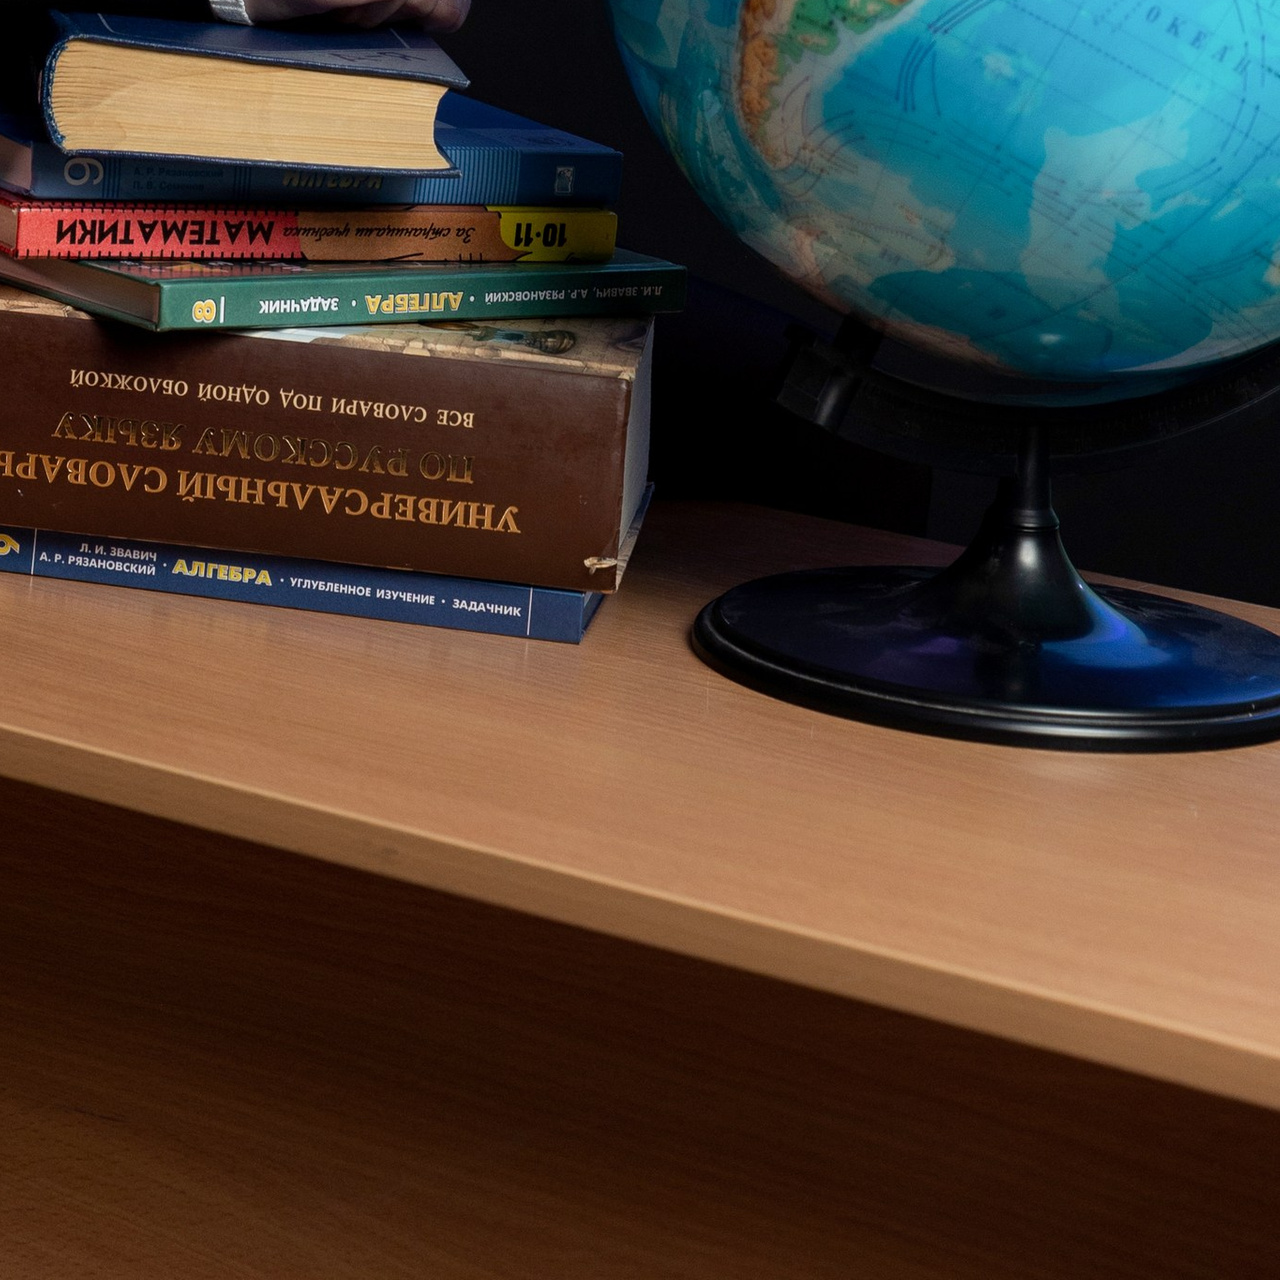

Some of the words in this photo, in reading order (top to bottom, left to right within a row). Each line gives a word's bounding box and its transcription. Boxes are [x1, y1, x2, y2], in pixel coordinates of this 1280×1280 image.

[1145, 6, 1251, 75] ОКЕАН
[56, 219, 275, 245] МАТЕМАТИКИ
[282, 222, 349, 243] учебника
[355, 222, 451, 241] страницами
[456, 227, 476, 244] За
[364, 292, 464, 315] АЛГЕБРА
[485, 289, 565, 305] РЯЗАНОВСКИЙ
[593, 286, 638, 298] ЗВАВИЧ,
[192, 299, 217, 324] 8
[259, 297, 339, 315] ЗАДАЧНИК
[69, 368, 189, 397] ОБЛОЖКОЙ
[197, 382, 270, 406] ОДНОЙ
[279, 387, 322, 411] ПОД
[331, 396, 428, 423] СЛОВАРИ
[436, 409, 475, 429] ВСЕ
[51, 411, 187, 452] ЯЗЫКУ
[192, 426, 411, 477] РУССКОМУ
[419, 450, 475, 484] ПО
[176, 469, 522, 534] УНИВЕРСАЛЬНЫЙ
[39, 551, 51, 562] А.
[54, 553, 65, 564] Р.
[68, 554, 156, 576] РЯЗАНОВСКИЙ
[79, 542, 92, 554] Л.
[95, 544, 107, 556] И.
[110, 546, 157, 562] ЗВАВИЧ
[172, 558, 272, 586] АЛГЕБРА
[289, 576, 372, 597] УГЛУБЛЕННОЕ
[376, 588, 435, 606] ИЗУЧЕНИЕ
[452, 598, 522, 617] ЗАДАЧНИК
